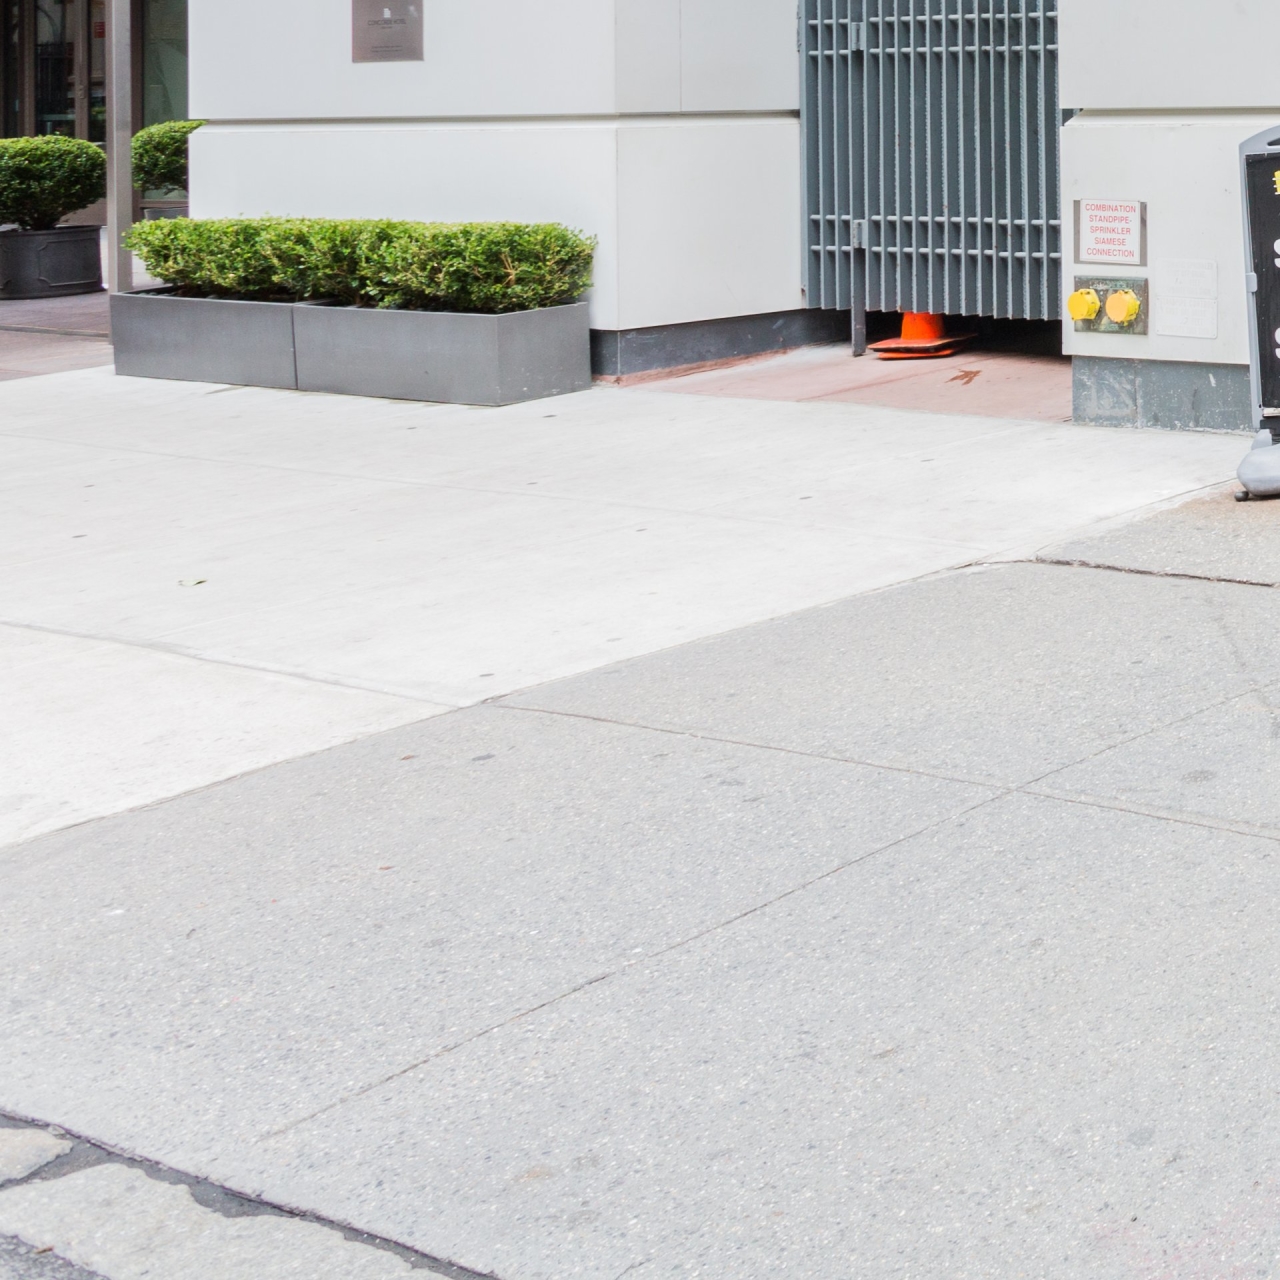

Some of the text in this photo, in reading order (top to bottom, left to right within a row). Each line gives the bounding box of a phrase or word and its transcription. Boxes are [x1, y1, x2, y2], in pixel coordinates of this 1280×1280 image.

[1085, 203, 1136, 213] COMBINATION
[1089, 214, 1132, 224] STANDPIPE-
[1090, 225, 1131, 235] SPRINKLER
[1094, 237, 1126, 246] SIAMESE
[1086, 247, 1134, 257] CONNECTION
